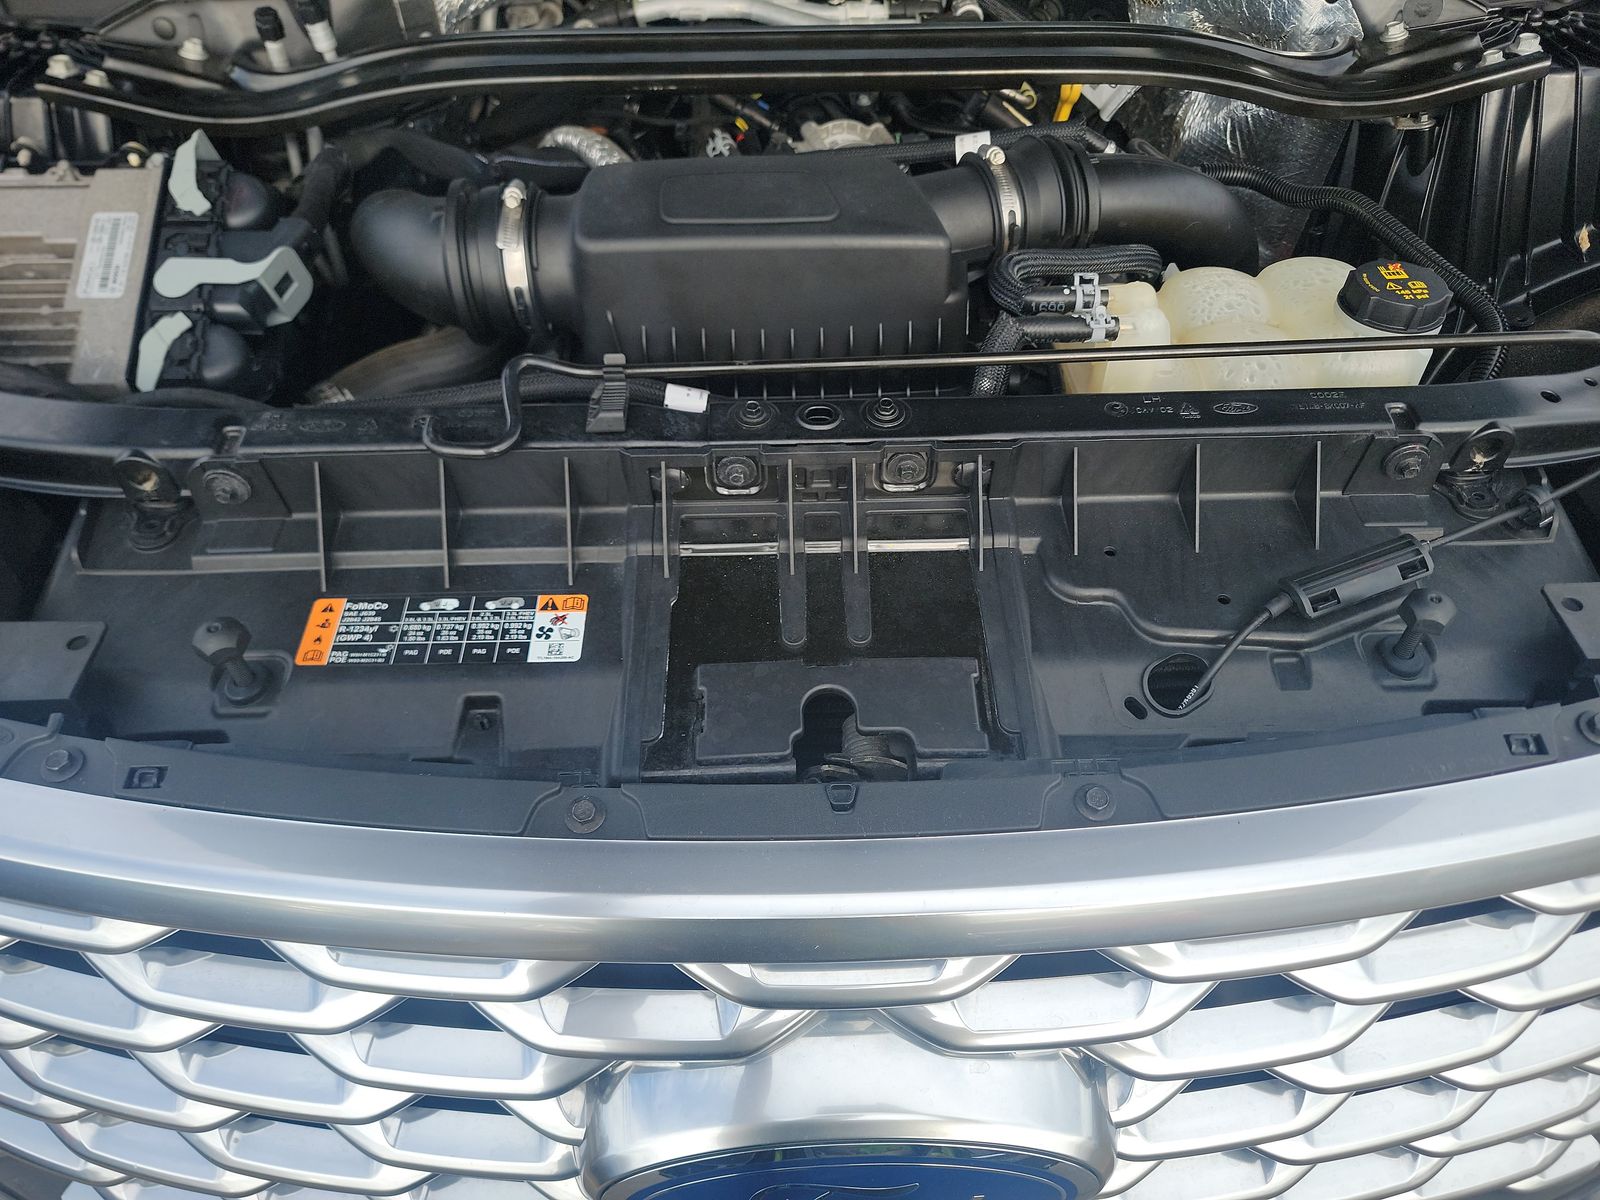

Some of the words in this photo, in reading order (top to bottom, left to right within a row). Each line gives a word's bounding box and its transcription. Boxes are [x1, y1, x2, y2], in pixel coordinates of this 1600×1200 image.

[346, 602, 389, 611] FoMoCo
[339, 625, 380, 634] R-1234yf
[422, 624, 432, 632] kg
[336, 634, 362, 642] (GWP
